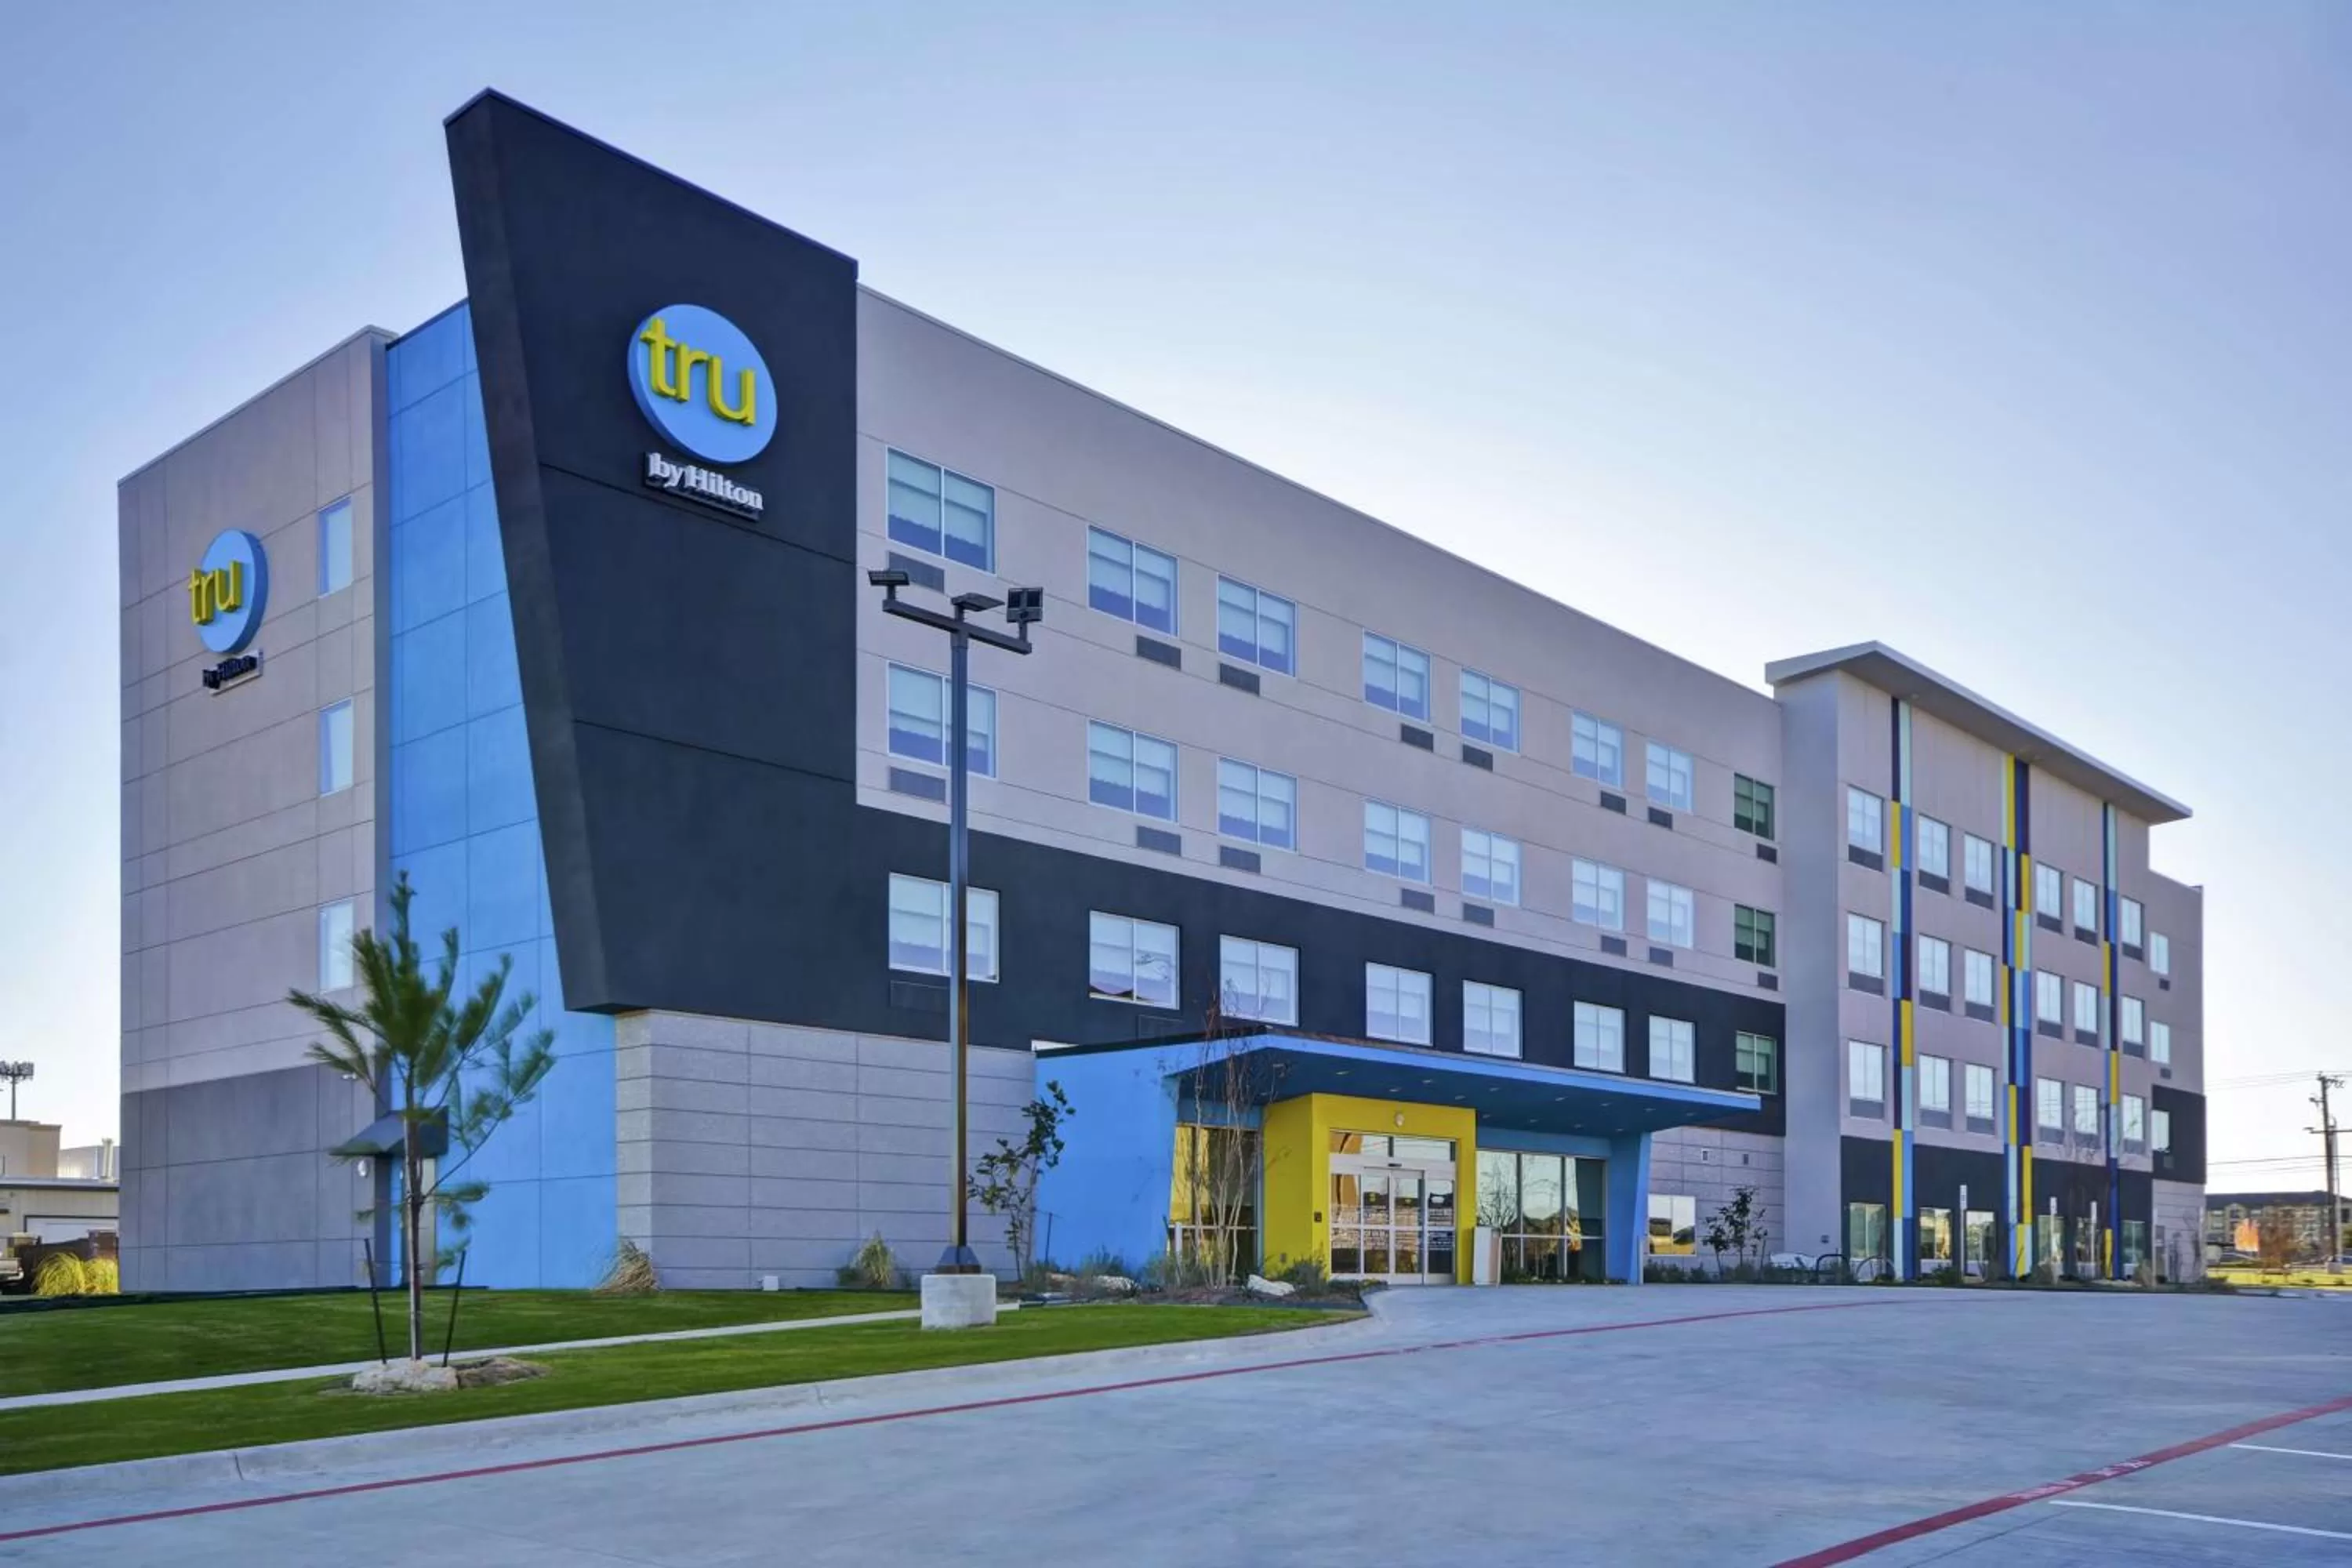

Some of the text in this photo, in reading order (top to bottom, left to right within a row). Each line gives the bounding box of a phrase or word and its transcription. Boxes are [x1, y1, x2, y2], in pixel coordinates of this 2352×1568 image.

[640, 318, 756, 426] tru
[648, 452, 764, 510] by Hilton
[189, 560, 243, 626] tru
